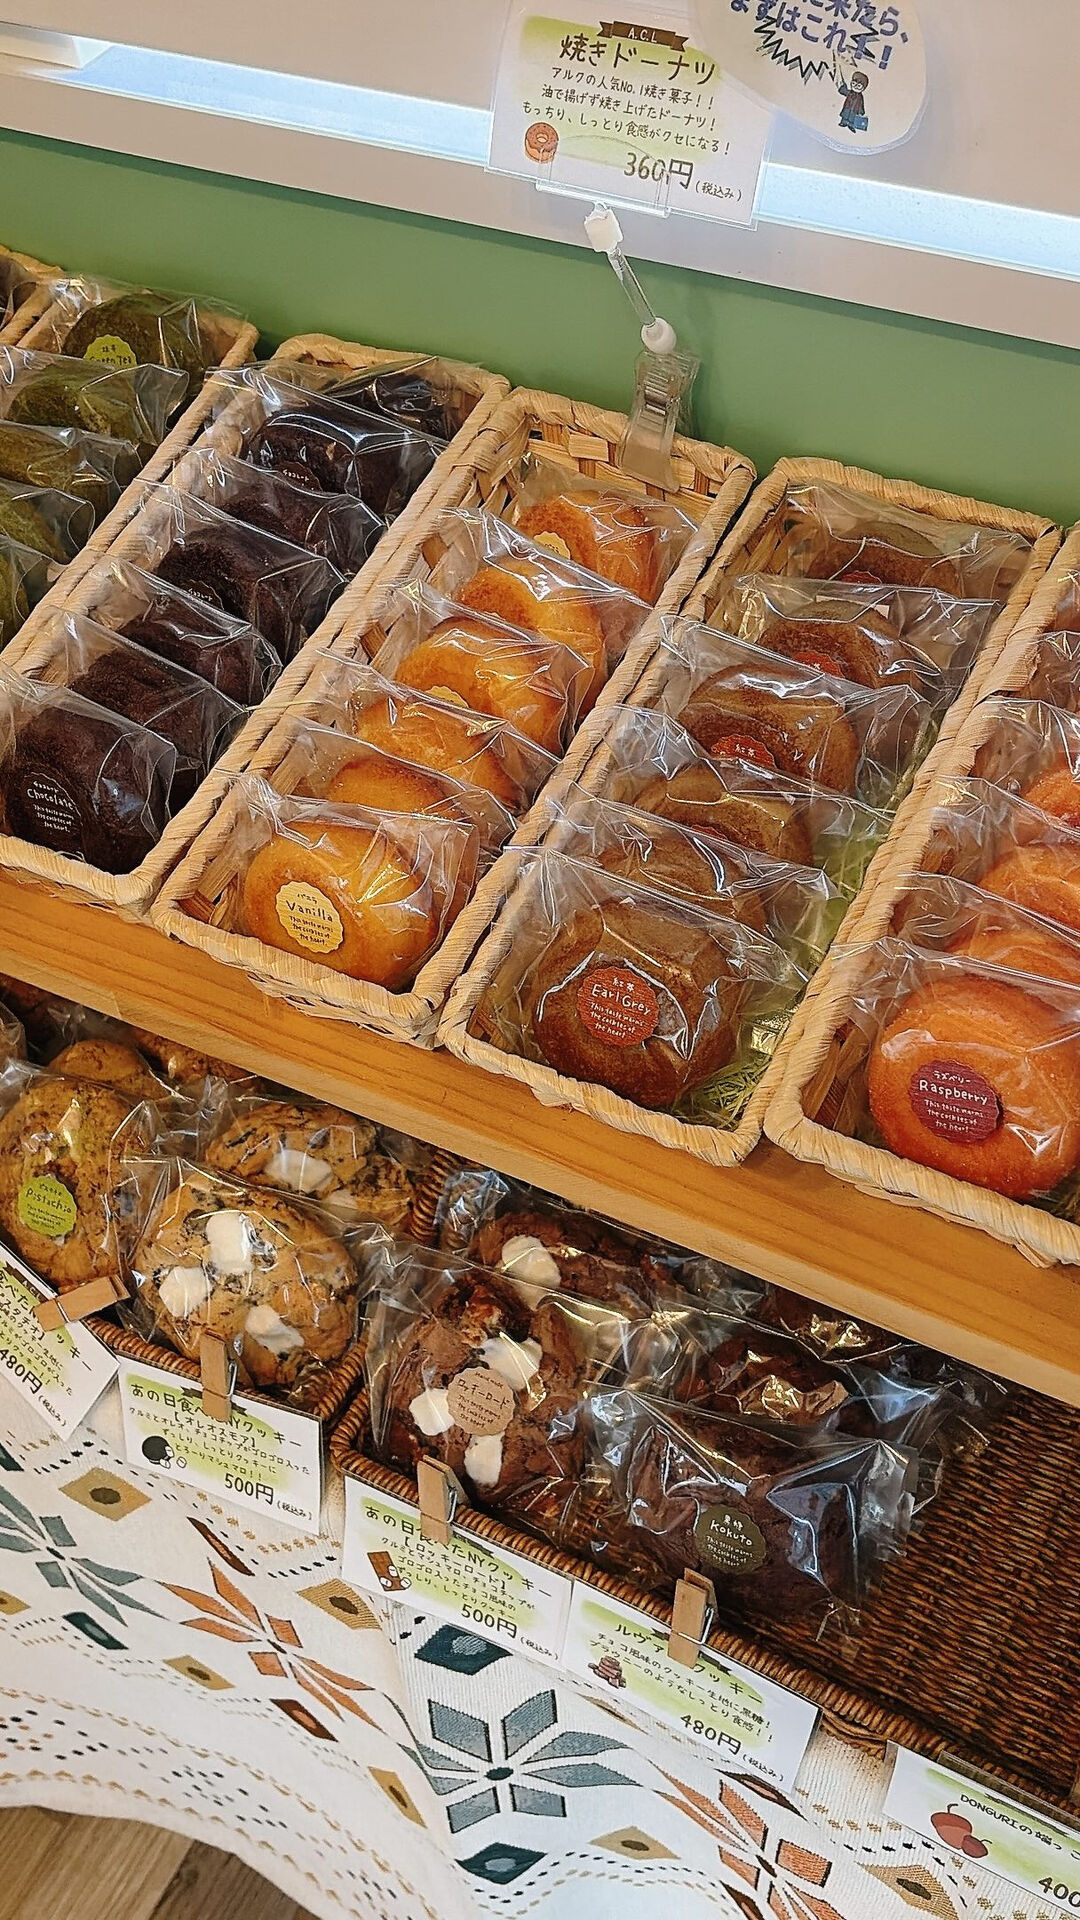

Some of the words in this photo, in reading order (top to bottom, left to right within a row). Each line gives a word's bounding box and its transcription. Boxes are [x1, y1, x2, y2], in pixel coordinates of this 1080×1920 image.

[628, 27, 657, 44] A.C.L
[805, 0, 908, 43] 来たら、
[559, 32, 716, 85] 焼きドーナツ
[541, 83, 716, 131] 油で揚げず焼き上げたドーナツ！
[522, 101, 730, 155] もっちり、しっとり食感がクセになる！
[624, 152, 694, 189] 360円
[695, 180, 742, 202] （税込み）
[27, 788, 74, 811] Chocolate
[285, 900, 333, 922] Vanilla
[592, 984, 620, 1002] Earl
[622, 995, 651, 1016] Grey
[612, 977, 635, 992] 紅茶
[919, 1079, 988, 1105] Raspberry
[933, 1070, 971, 1083] ラズベリー
[25, 1187, 72, 1213] Pistachio
[0, 1291, 45, 1341] スタチオ】
[0, 1349, 43, 1394] 480円
[130, 1383, 302, 1447] あの日食べNYクッキー
[224, 1473, 274, 1505] 500円
[710, 1519, 753, 1546] Kokuto
[461, 1604, 518, 1639] 500円
[615, 1624, 763, 1704] ルヴァクッキー
[680, 1714, 742, 1755] 480円
[1038, 1876, 1080, 1908] 400
